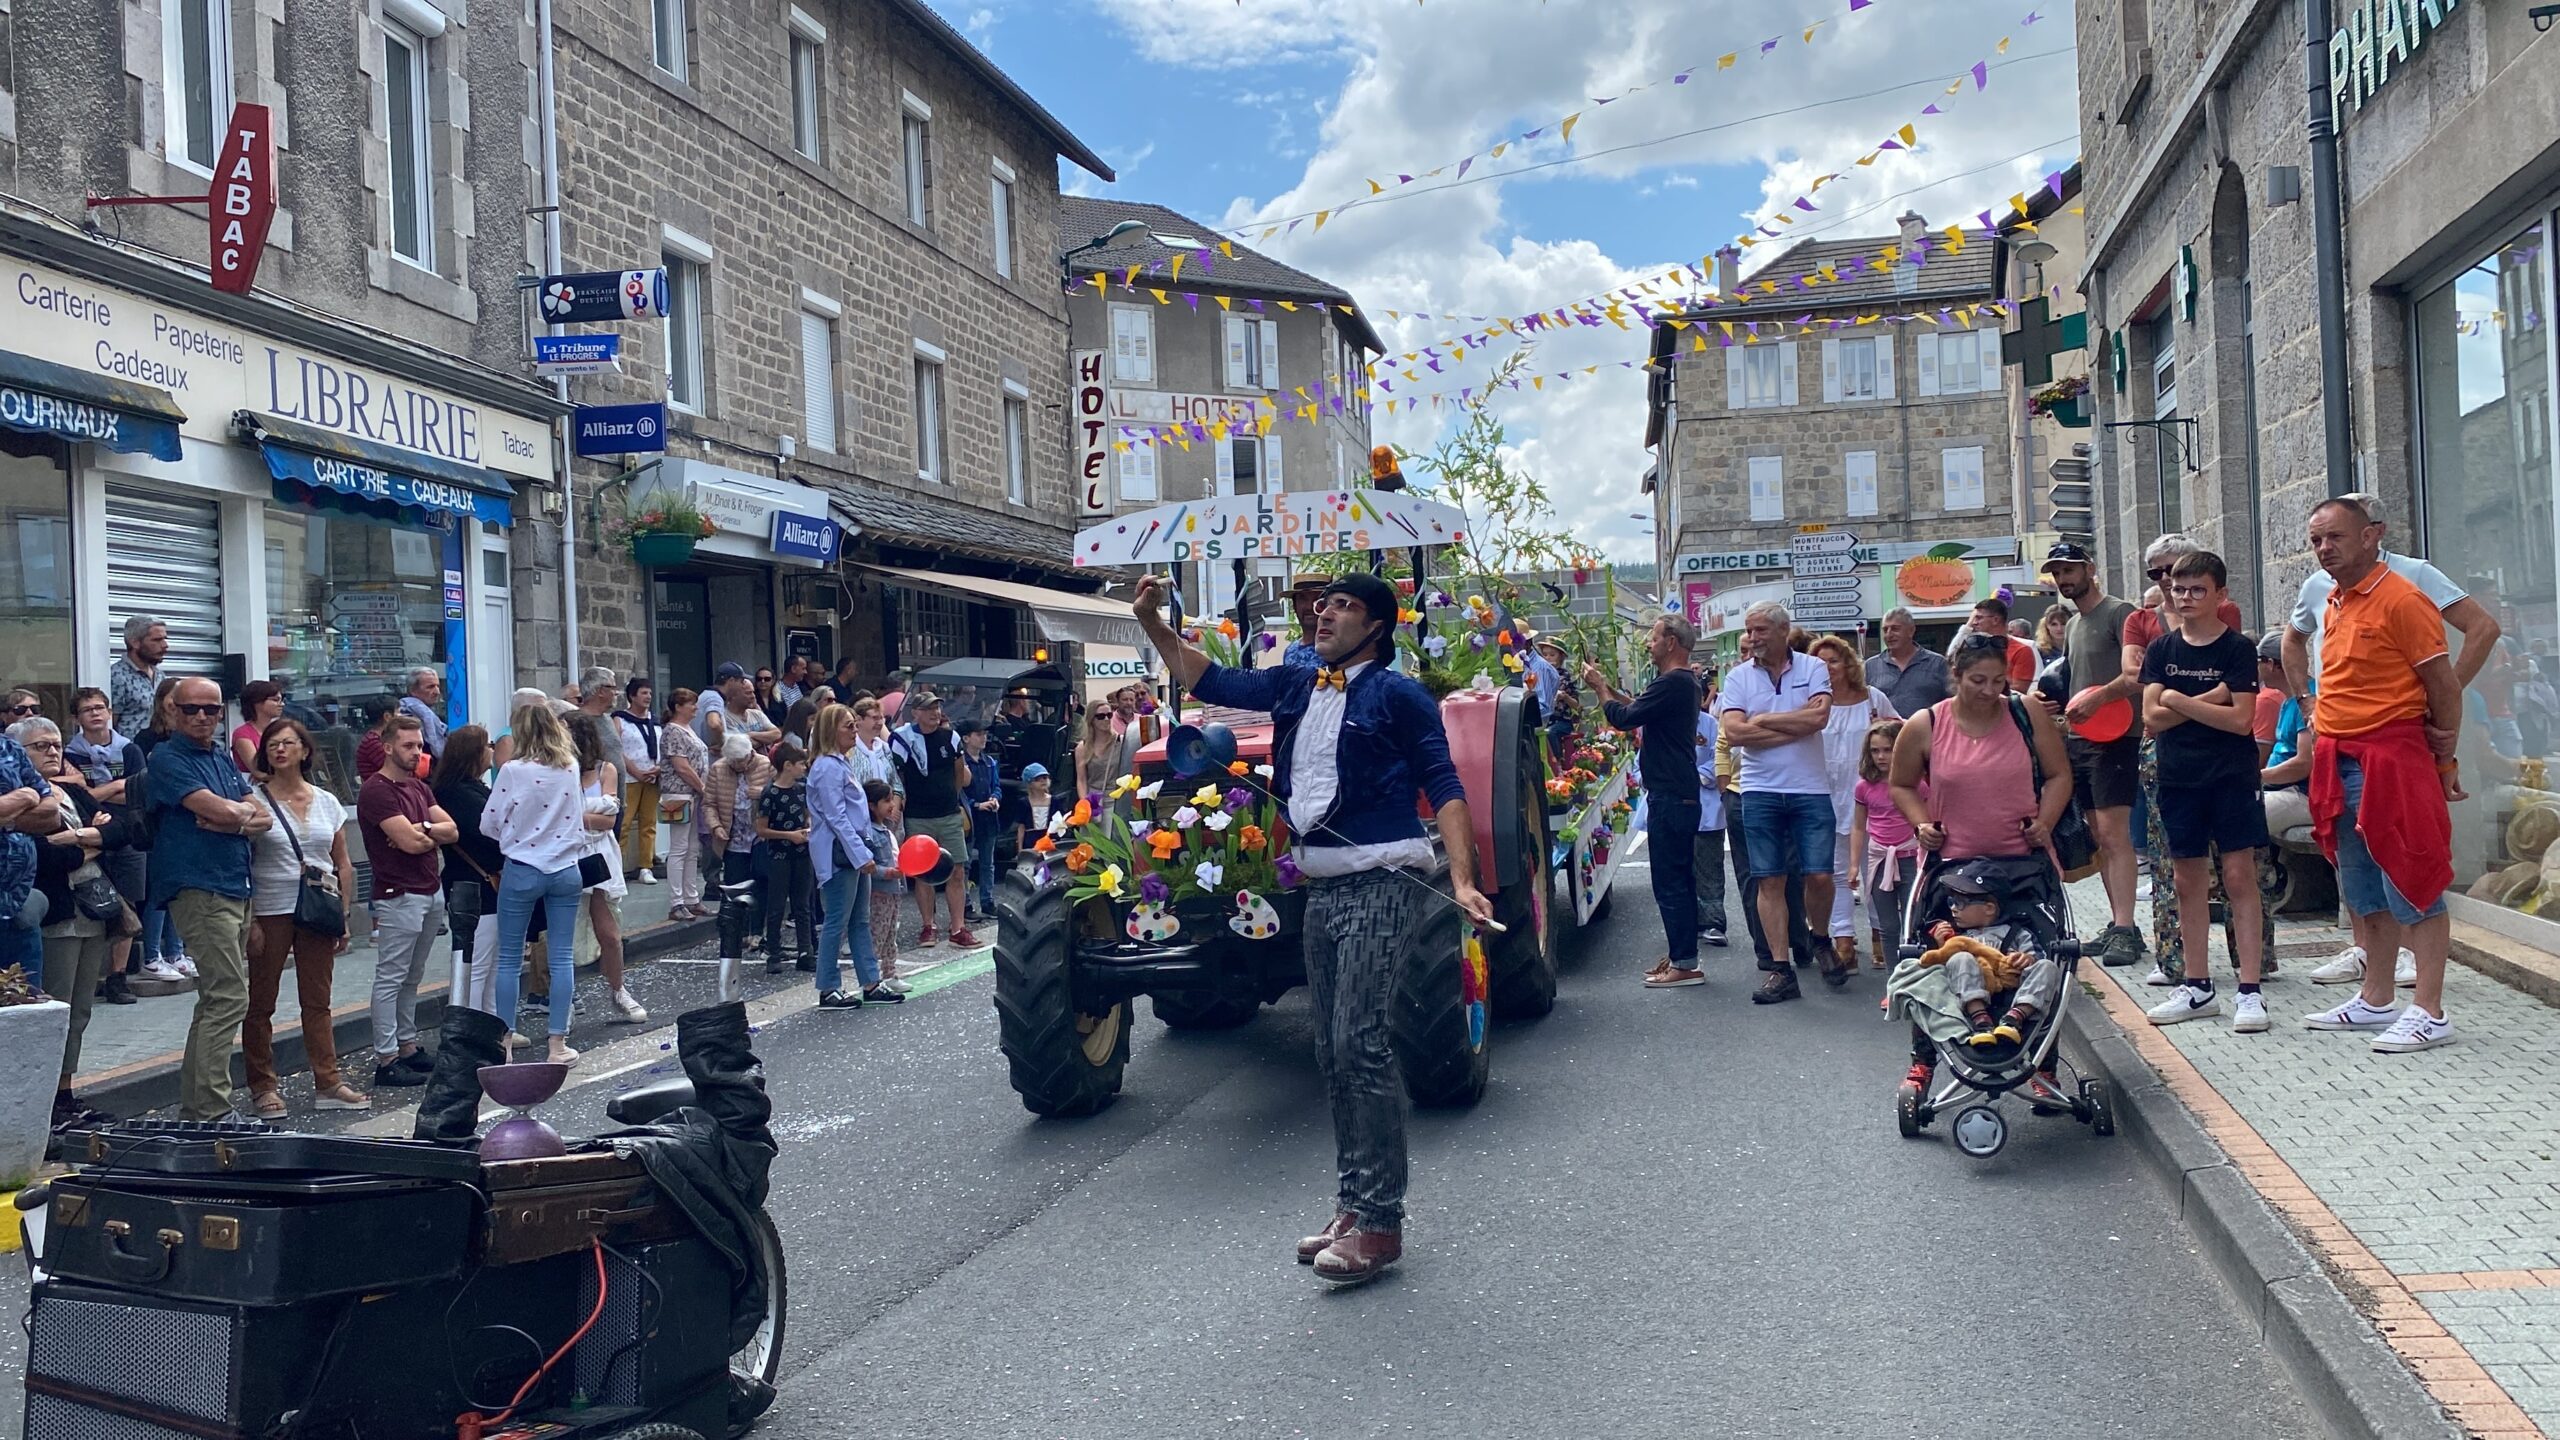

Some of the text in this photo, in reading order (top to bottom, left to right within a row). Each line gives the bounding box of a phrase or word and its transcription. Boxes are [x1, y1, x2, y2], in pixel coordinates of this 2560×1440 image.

[221, 129, 256, 271] TABAC
[18, 272, 111, 326] Carterie
[596, 296, 614, 304] JEUX
[154, 313, 244, 365] Papeterie
[543, 342, 607, 354] La Tribune
[96, 340, 189, 391] Cadeaux
[549, 353, 560, 361] LE
[265, 347, 480, 464] LIBRAIRIE
[582, 422, 634, 437] Allianz
[1080, 354, 1106, 510] HOTEL
[501, 430, 535, 459] Tabac
[411, 478, 476, 512] CADEAUX
[1257, 492, 1289, 514] LE
[783, 521, 819, 547] Allianz
[1794, 535, 1846, 545] MONTFAUCON
[1174, 539, 1222, 561] DES
[1795, 544, 1822, 552] TENCE
[1687, 554, 1750, 571] OFFICE
[1756, 553, 1779, 566] DE
[1807, 564, 1844, 573] ÉTIENNE
[1904, 555, 1964, 571] RESTAURANT
[1822, 579, 1854, 587] Devesset
